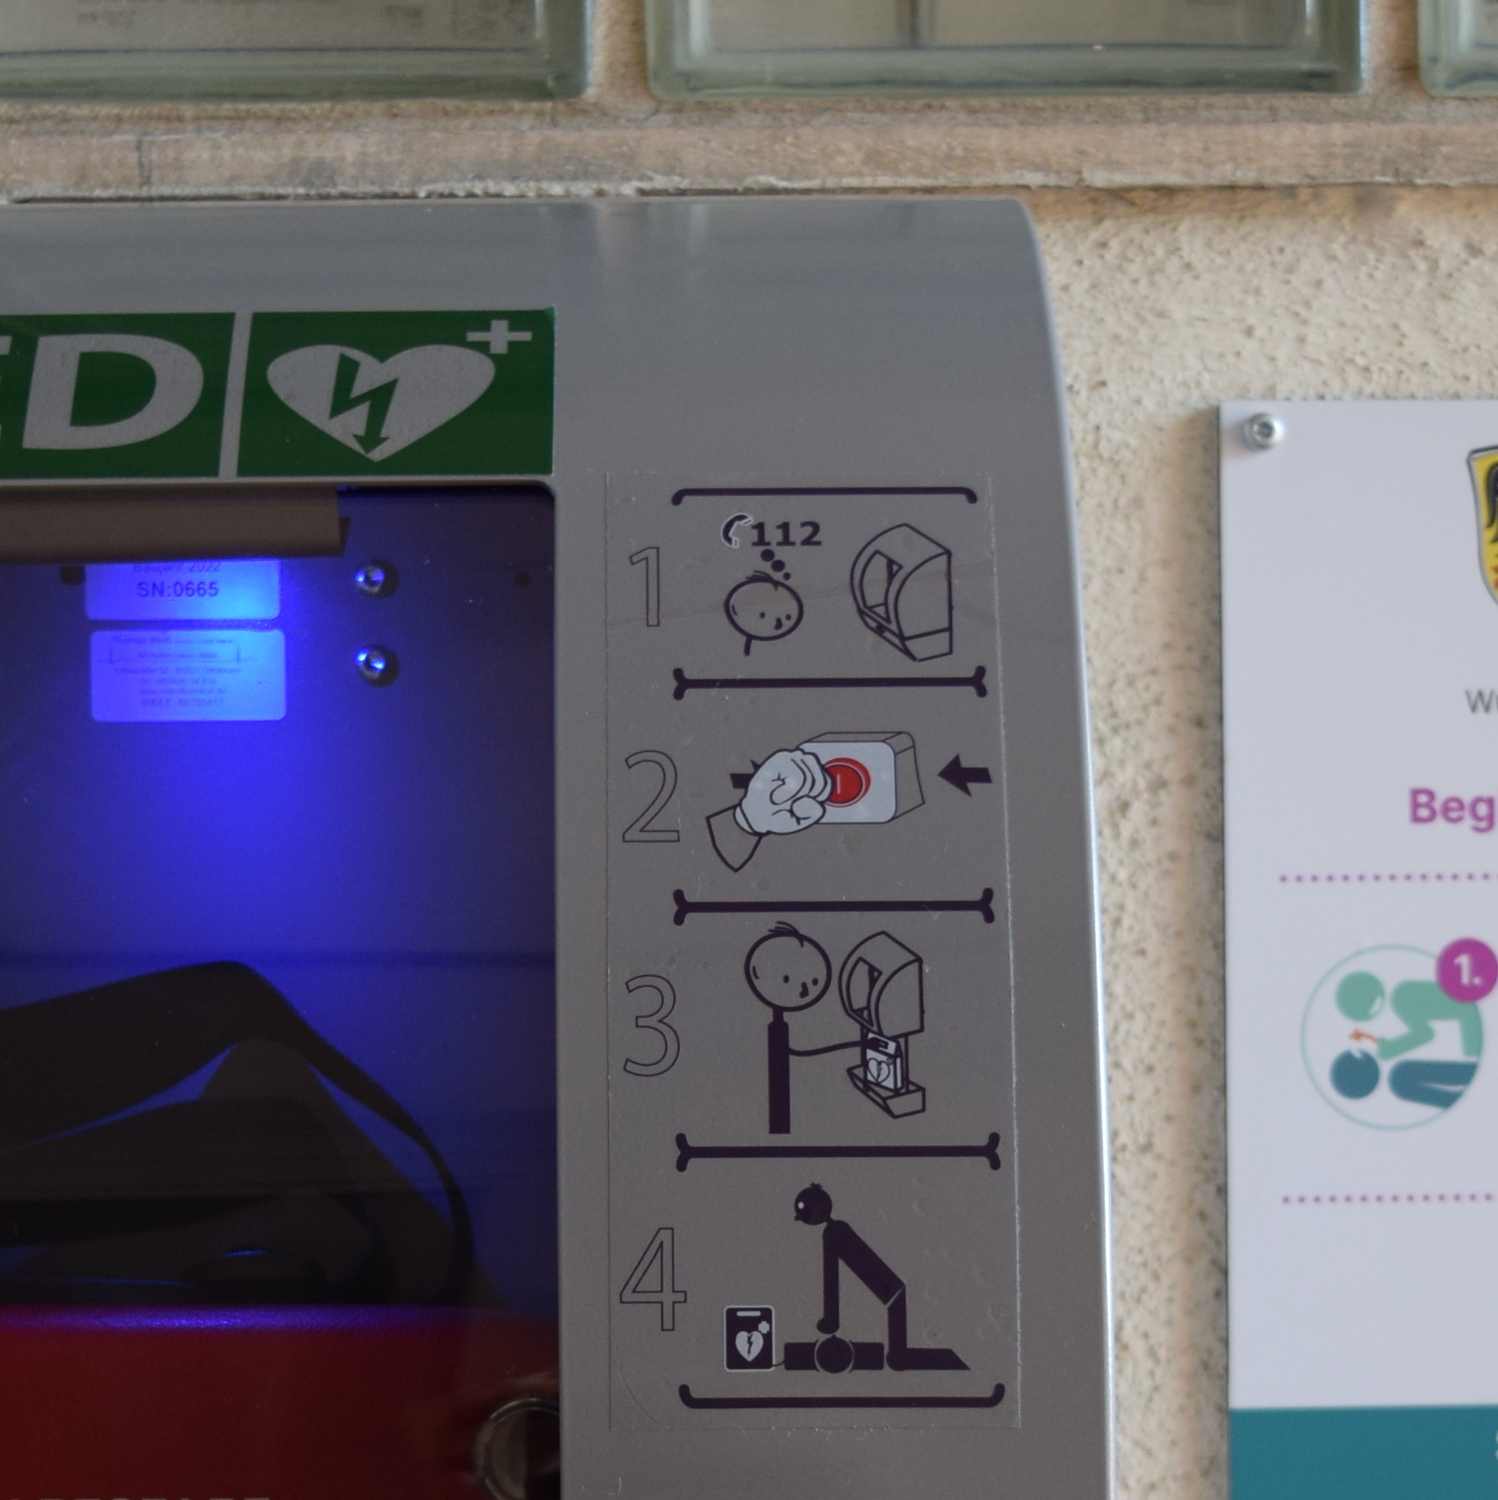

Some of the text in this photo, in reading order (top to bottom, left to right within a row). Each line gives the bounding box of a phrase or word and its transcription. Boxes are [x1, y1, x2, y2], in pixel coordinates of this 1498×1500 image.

[750, 520, 822, 547] 112
[137, 581, 219, 598] SN:0665
[629, 546, 660, 627] 1
[622, 749, 680, 842] 2
[1453, 953, 1483, 986] 1.
[622, 974, 680, 1077] 3
[619, 1227, 687, 1331] 4
